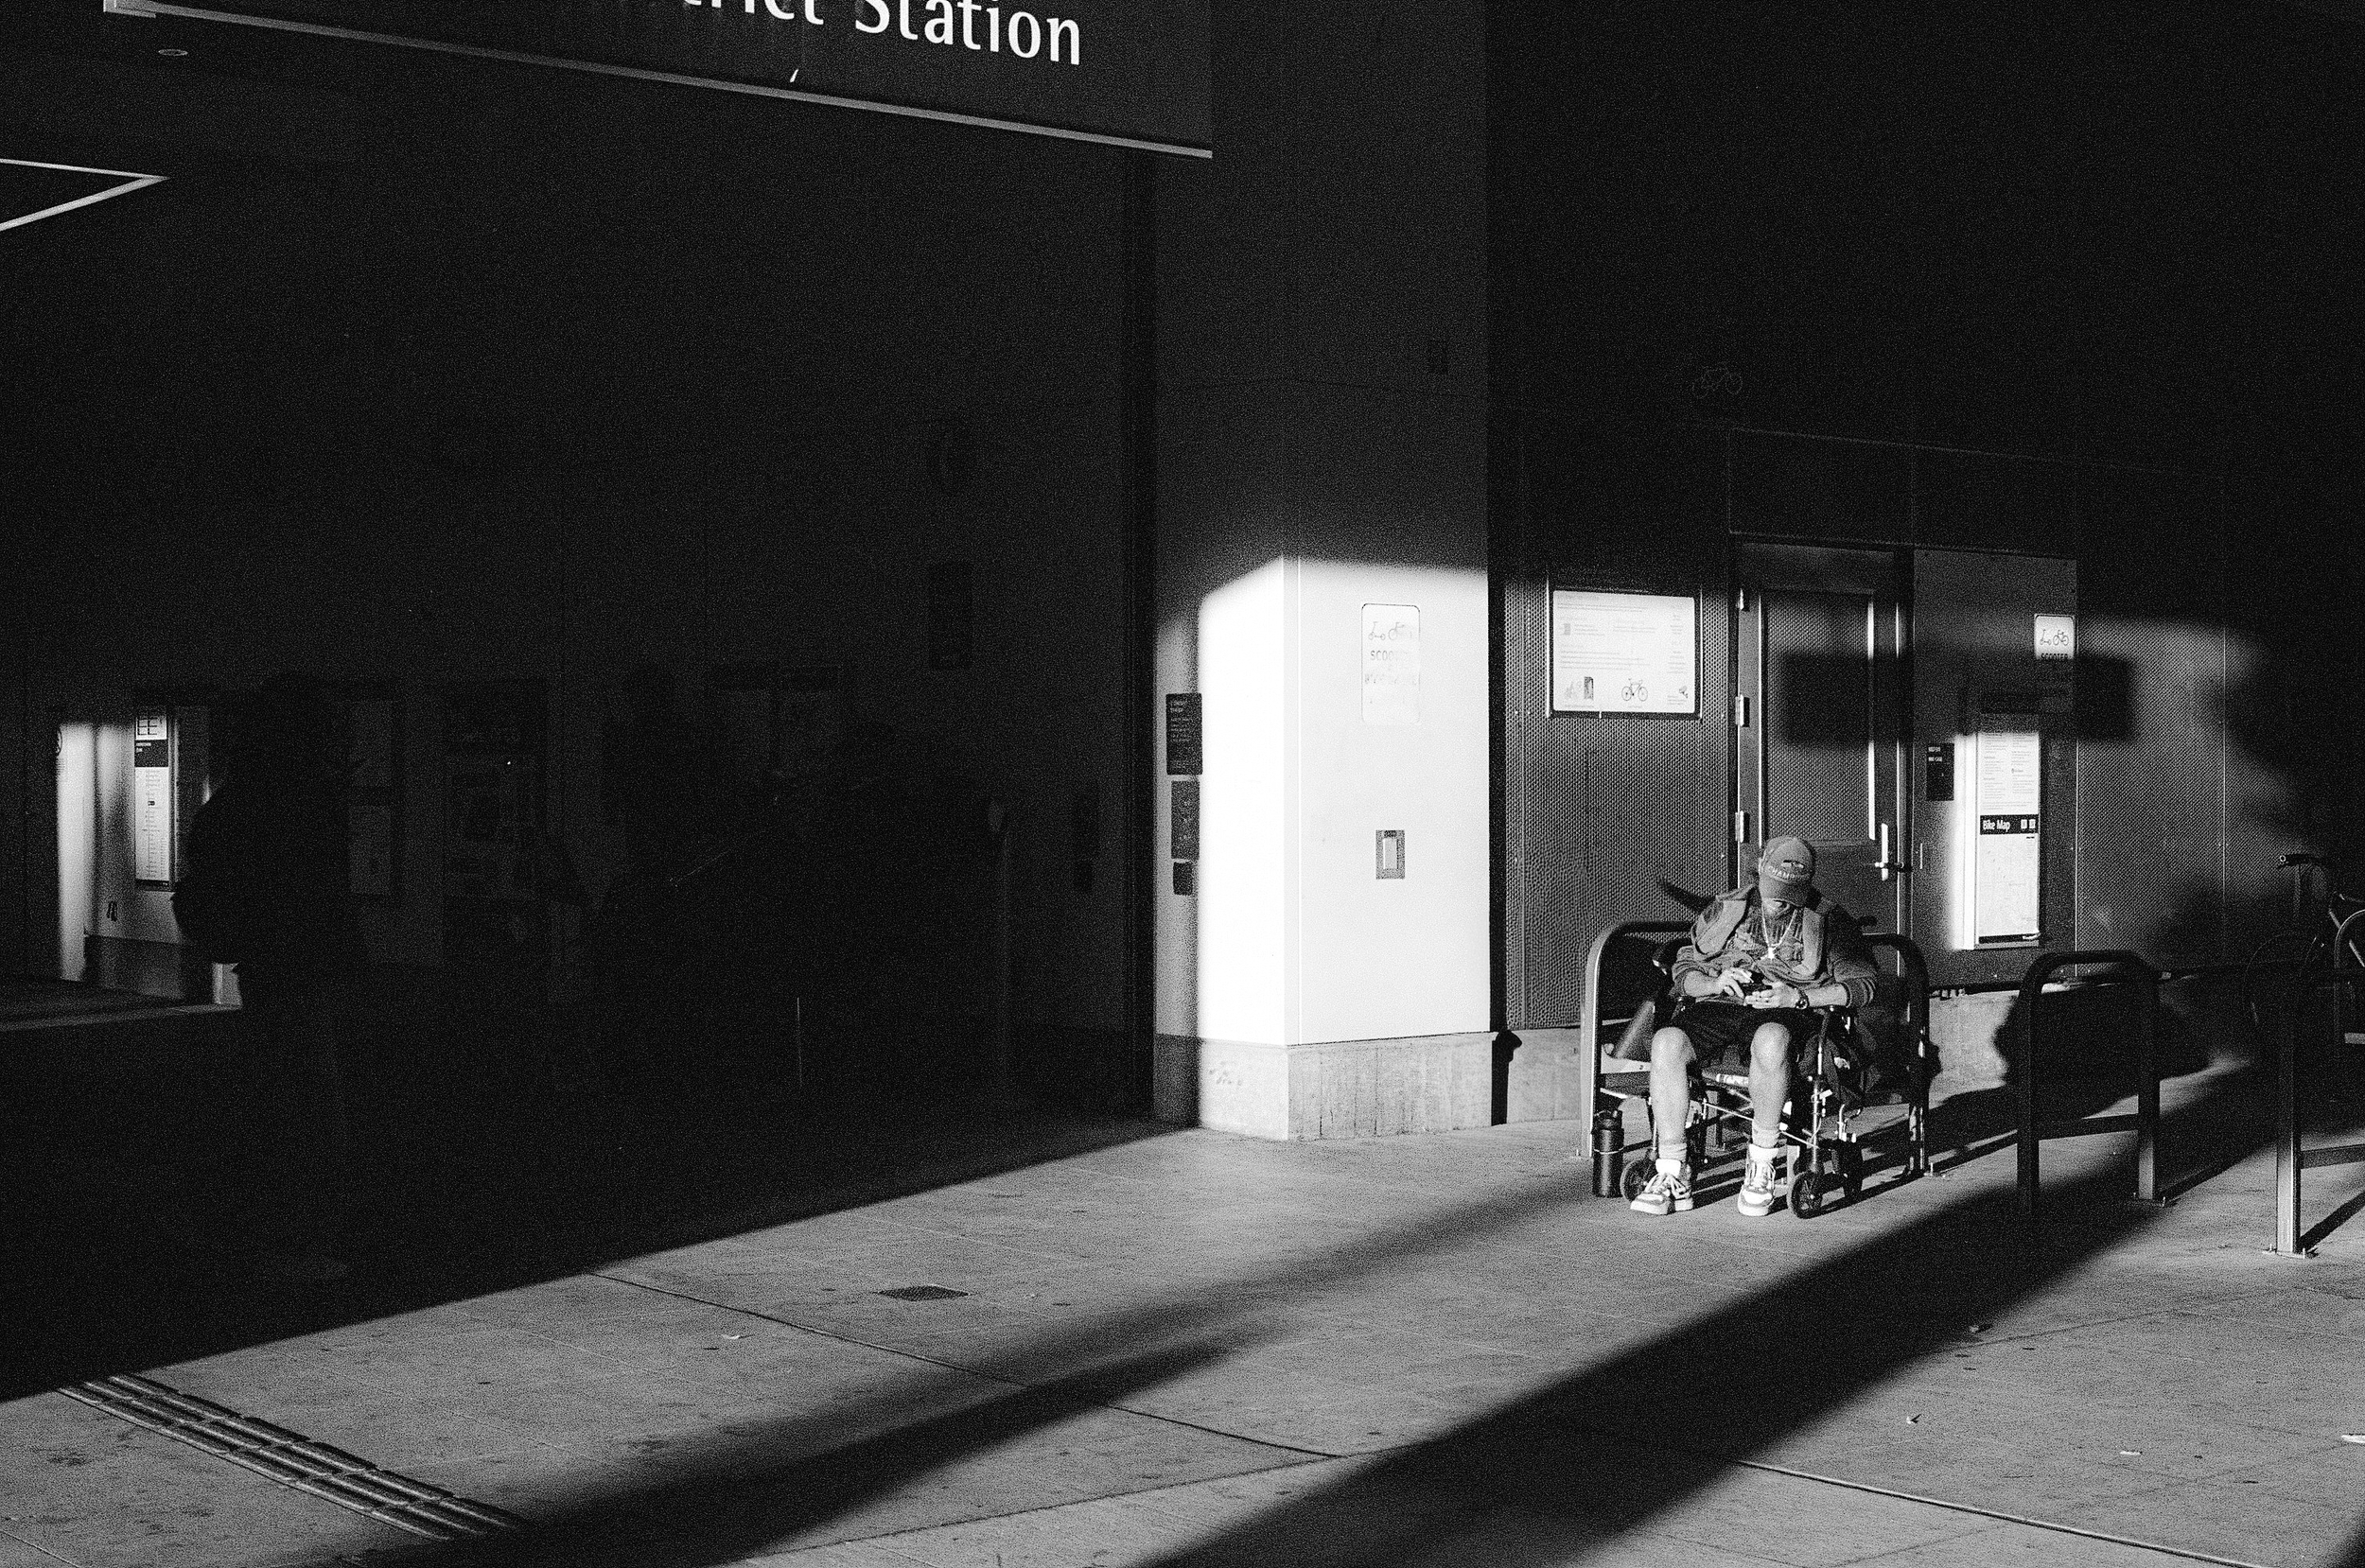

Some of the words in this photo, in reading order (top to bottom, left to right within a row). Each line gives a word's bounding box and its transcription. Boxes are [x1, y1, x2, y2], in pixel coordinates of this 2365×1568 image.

[855, 0, 1080, 66] Station
[1982, 819, 1996, 830] Bike
[1996, 819, 2011, 832] Map
